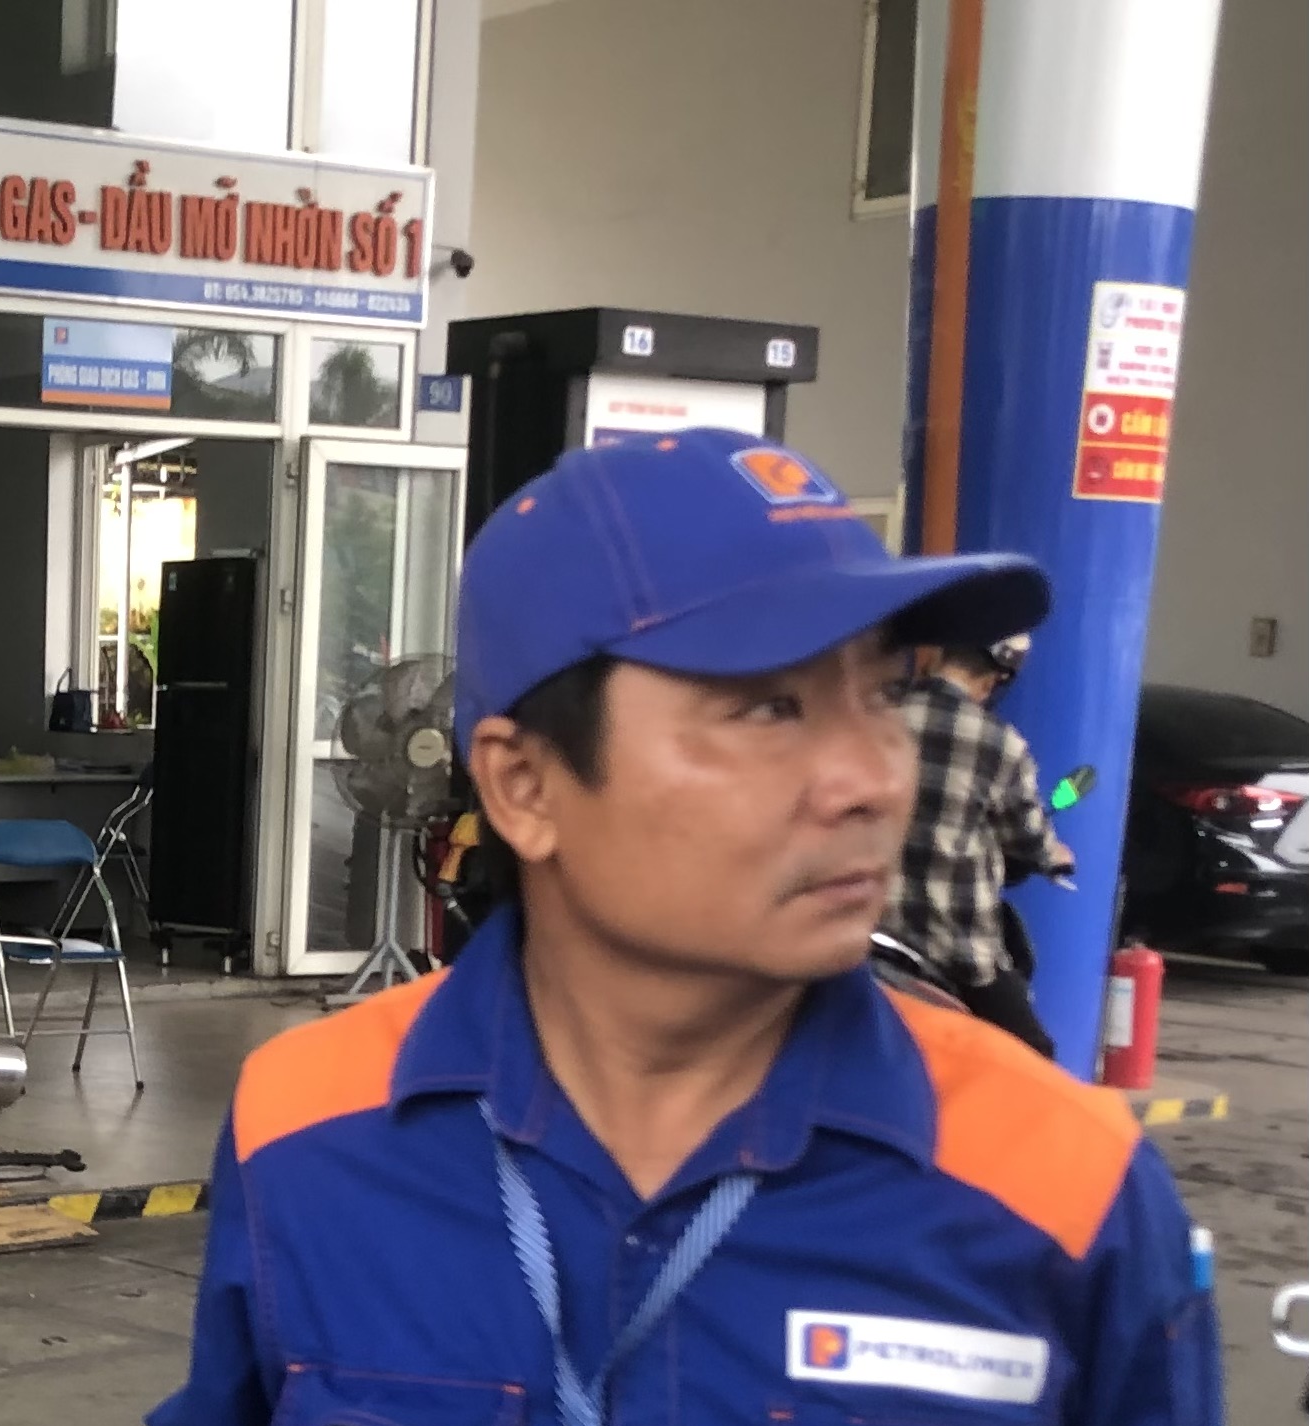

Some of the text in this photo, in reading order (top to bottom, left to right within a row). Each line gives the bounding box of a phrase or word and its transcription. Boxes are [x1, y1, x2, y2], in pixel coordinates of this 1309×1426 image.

[403, 218, 423, 278] 1
[628, 331, 790, 363] 16 15
